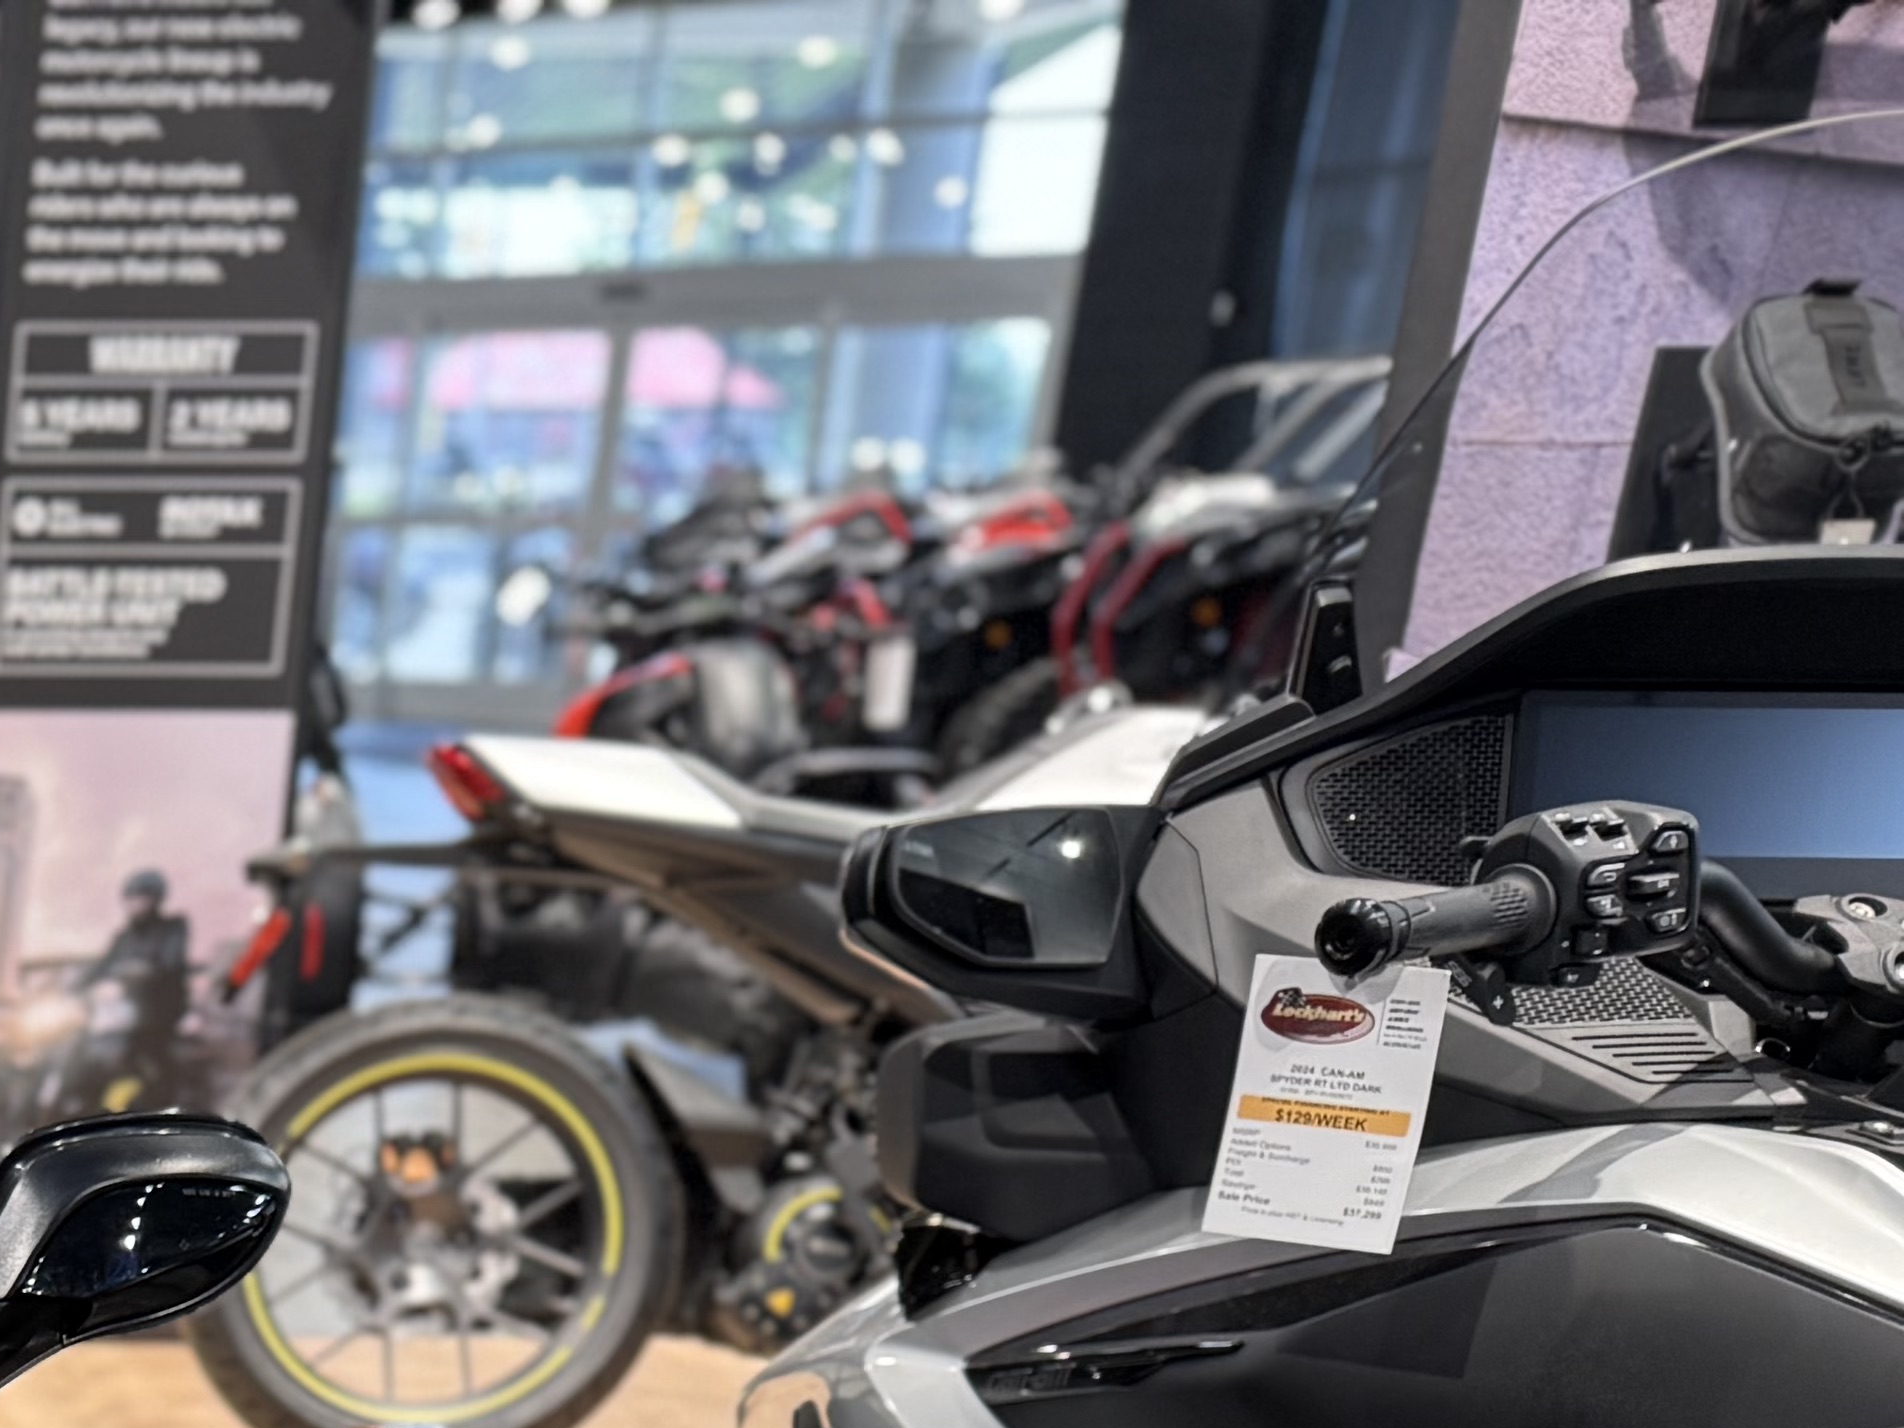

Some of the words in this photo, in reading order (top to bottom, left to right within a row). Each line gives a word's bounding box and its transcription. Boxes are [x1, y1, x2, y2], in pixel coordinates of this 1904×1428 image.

[215, 12, 301, 41] electric
[39, 46, 162, 77] motorcycle
[37, 79, 197, 112] revolutionizing
[198, 78, 235, 107] the
[238, 78, 333, 112] industry
[34, 115, 92, 141] once
[31, 157, 83, 189] Built
[86, 157, 117, 189] for
[118, 157, 157, 189] the
[159, 158, 245, 189] curious
[27, 190, 94, 222] riders
[97, 190, 145, 222] who
[146, 194, 186, 222] are
[189, 191, 262, 226] always
[264, 194, 299, 221] on
[25, 224, 64, 253] the
[130, 223, 173, 252] and
[175, 223, 254, 257] looking
[255, 224, 286, 252] to
[118, 255, 170, 285] their
[90, 336, 240, 375] WARRANTY
[42, 398, 142, 432] YEARS
[194, 398, 291, 432] YEARS
[1270, 1073, 1311, 1086] SPYDER
[1314, 1078, 1328, 1088] RT
[1330, 1080, 1351, 1091] LTD
[1352, 1082, 1382, 1094] DARK
[1321, 1066, 1365, 1080] CAN-AM
[1275, 1108, 1367, 1132] $129/WEEK
[1227, 1147, 1257, 1160] Freight
[1259, 1140, 1291, 1152] Options
[1218, 1190, 1240, 1202] Sale
[1242, 1193, 1270, 1206] Price
